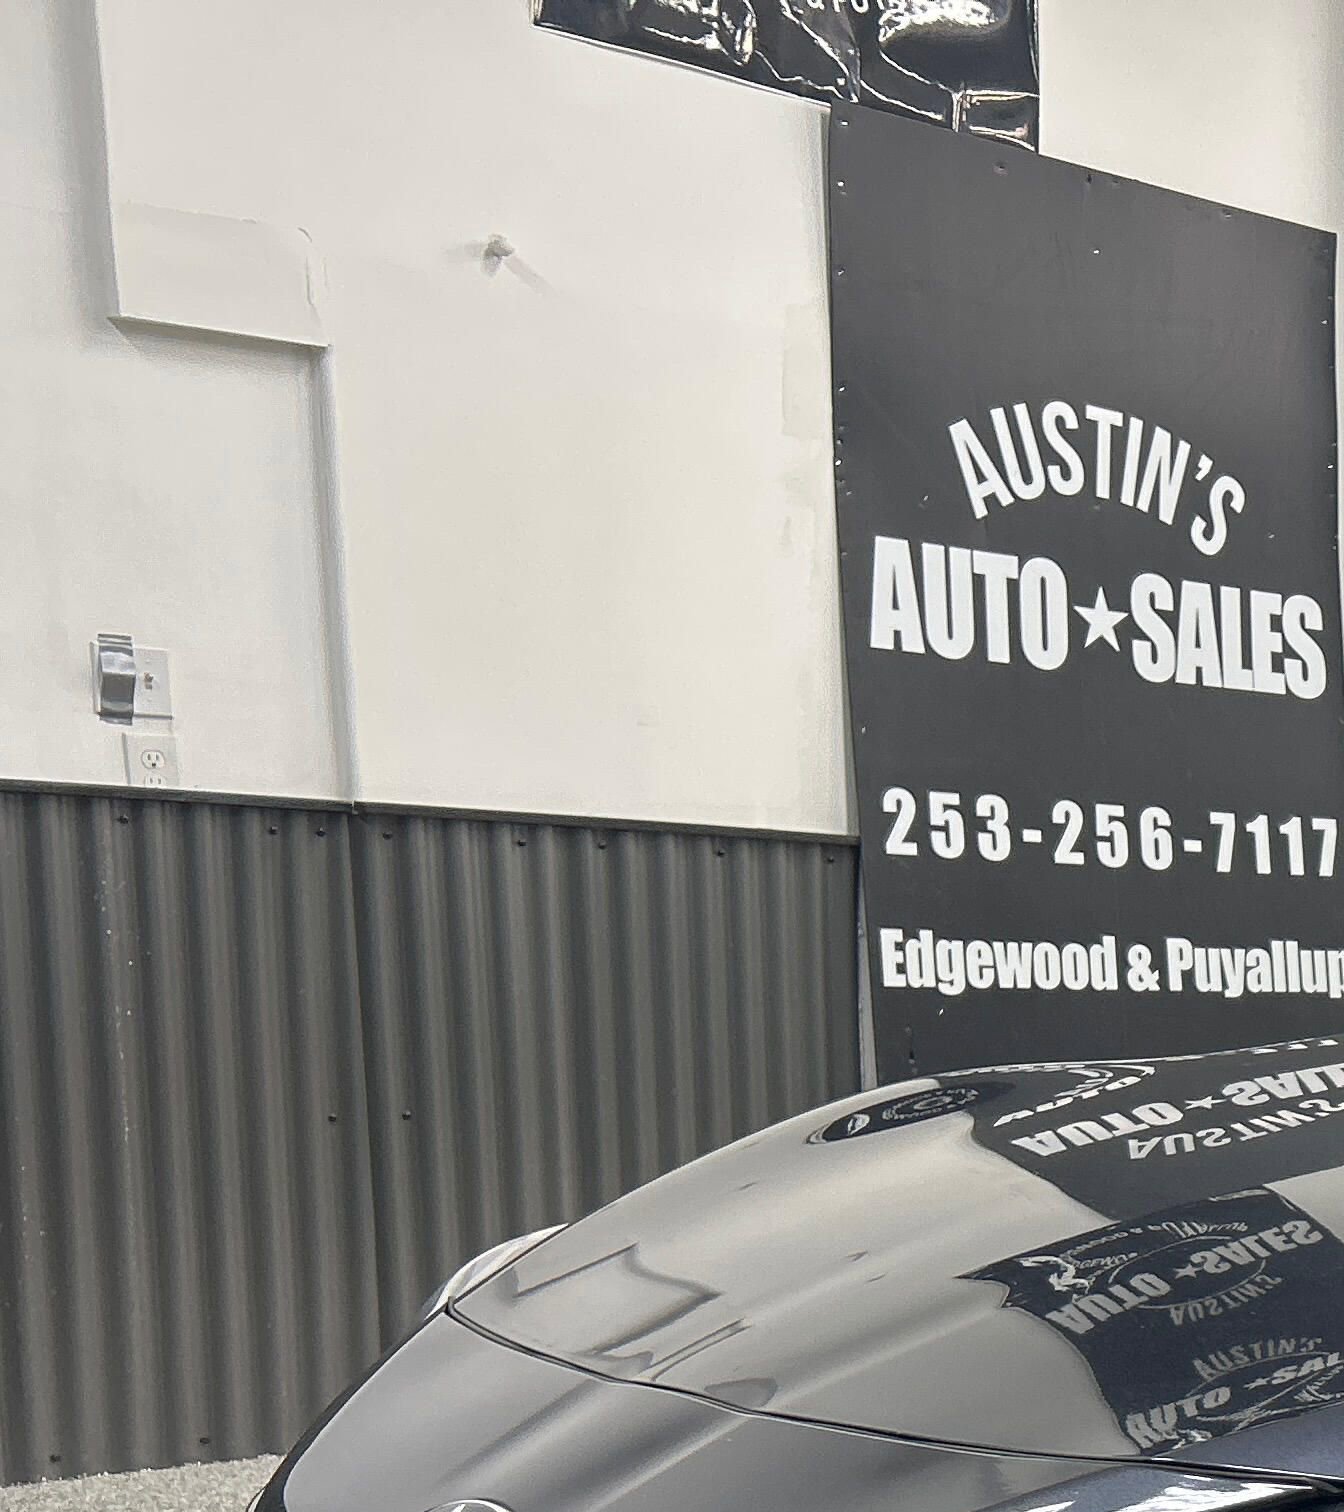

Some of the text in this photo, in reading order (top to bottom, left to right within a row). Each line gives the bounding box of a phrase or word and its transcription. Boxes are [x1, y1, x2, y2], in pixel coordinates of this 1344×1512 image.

[949, 401, 1244, 555] AUSTIN'S
[870, 536, 1326, 699] AUTO SALES
[883, 788, 1337, 876] 253-256-7117
[880, 928, 1118, 995] Edgewood
[1127, 944, 1160, 991] &
